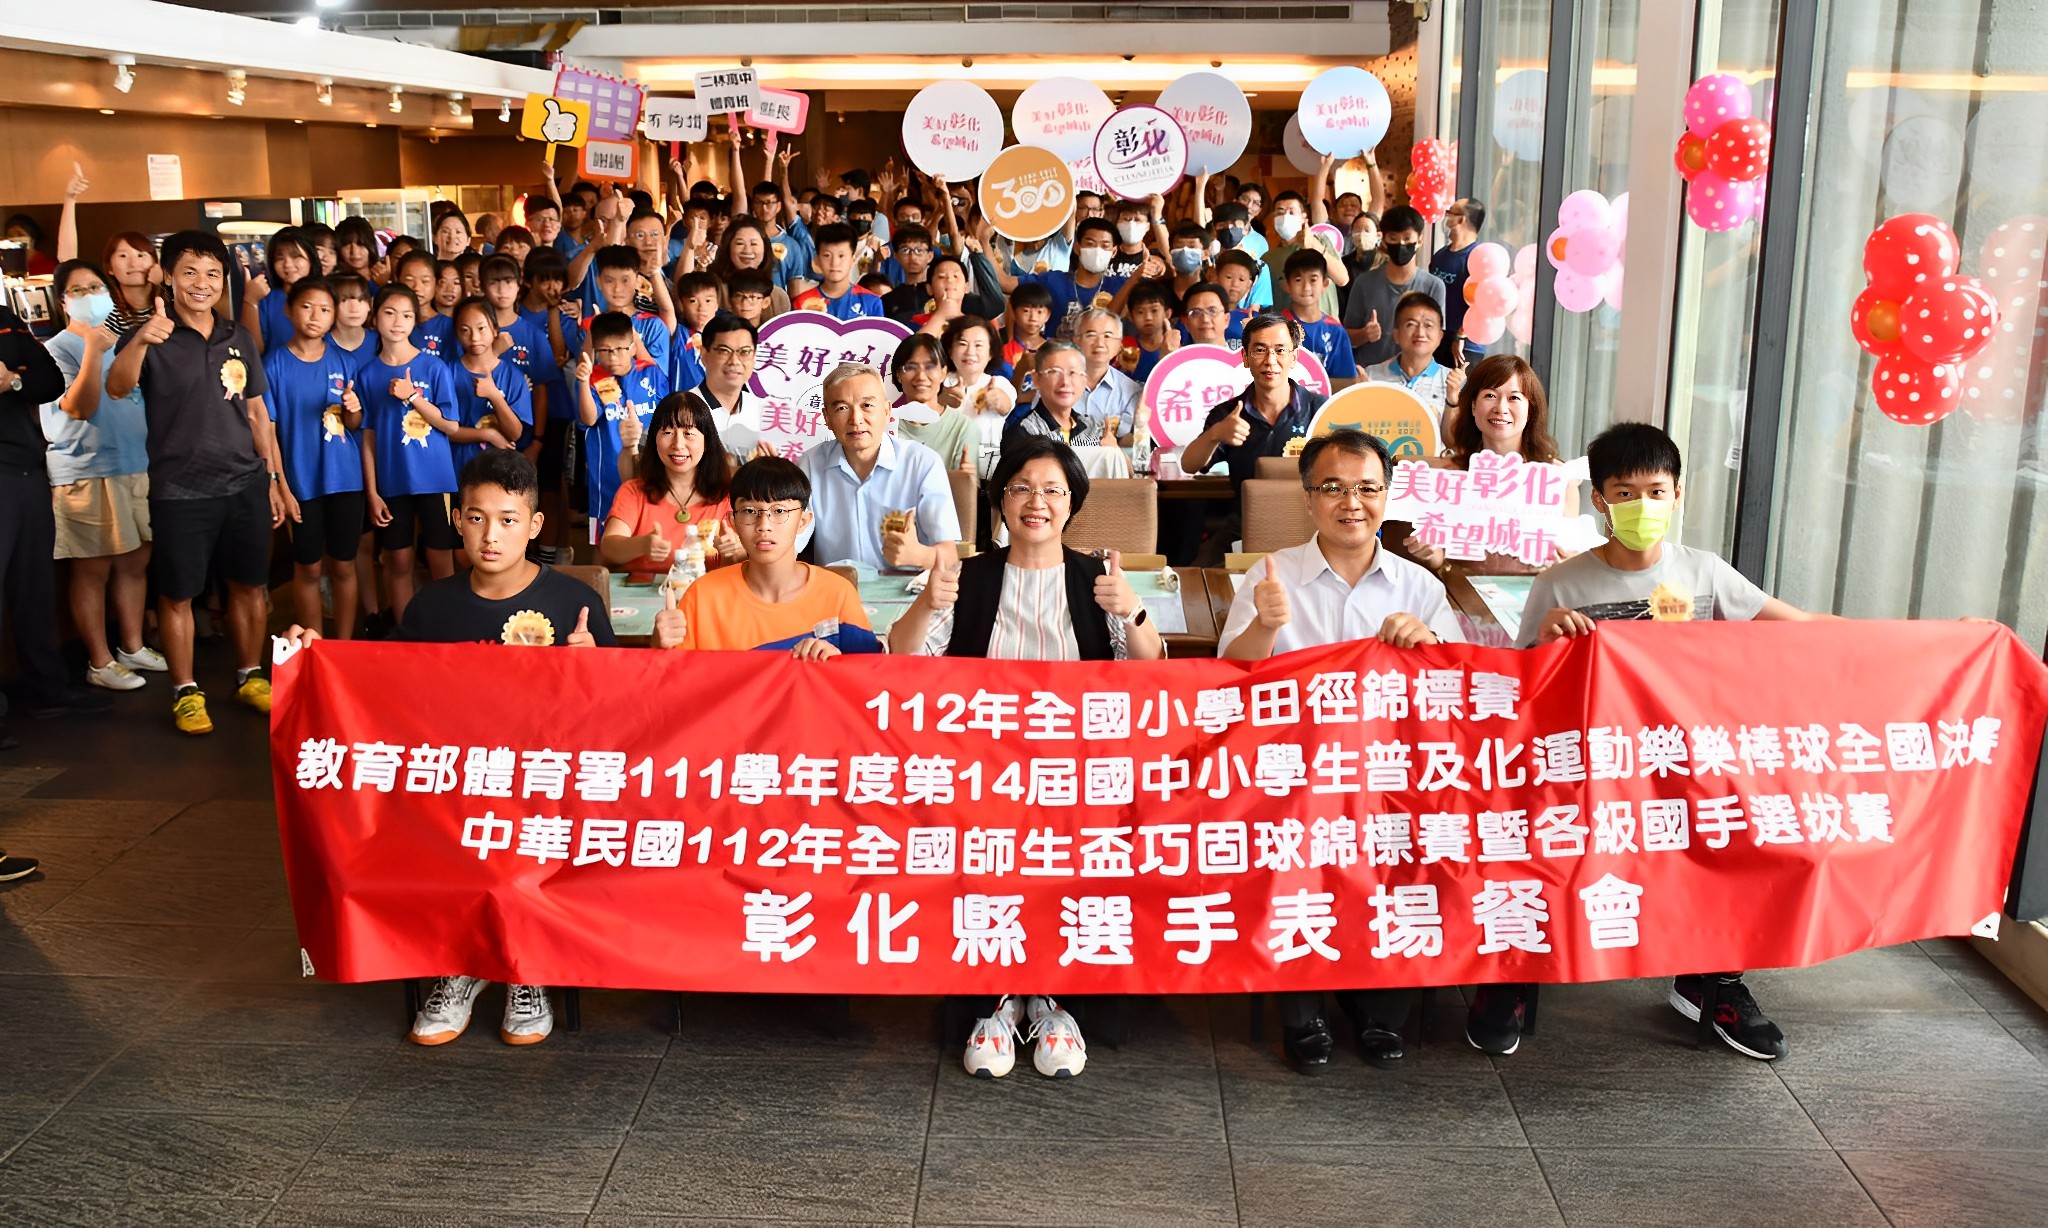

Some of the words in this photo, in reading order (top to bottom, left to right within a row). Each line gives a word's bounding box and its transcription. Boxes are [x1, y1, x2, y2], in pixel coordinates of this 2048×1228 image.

[1114, 117, 1169, 157] 彰化
[1391, 452, 1562, 506] 美好彰化
[1415, 511, 1558, 563] 希望城市
[866, 667, 1521, 740] 112年全國小學田徑錦標賽
[295, 715, 2002, 807] 教育部體育署111學年度第14屆國中小學生普及化運動樂樂棒球全國決賽
[461, 792, 1895, 878] 中華民國112年全國師生盃巧固球錦標賽暨各級國手選拔賽
[741, 872, 1644, 967] 彰化縣選手表揚餐會
